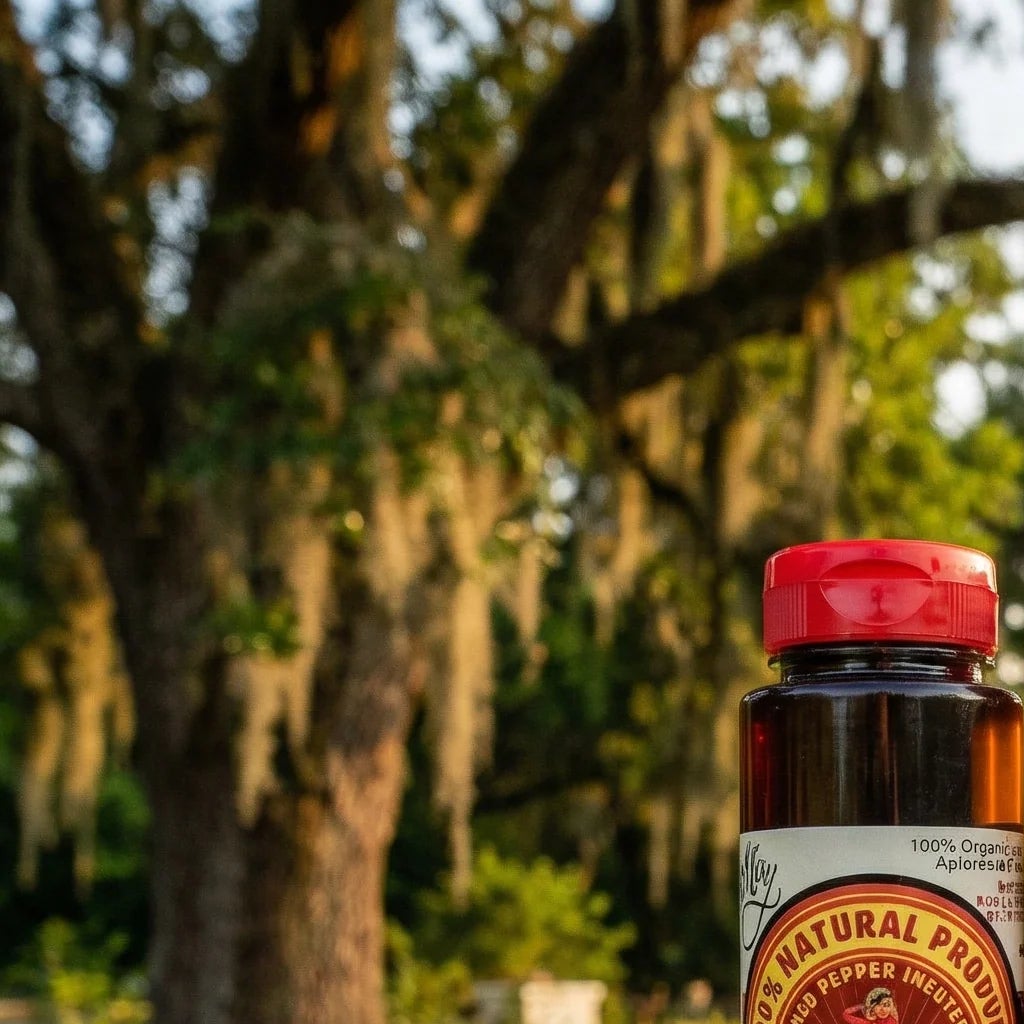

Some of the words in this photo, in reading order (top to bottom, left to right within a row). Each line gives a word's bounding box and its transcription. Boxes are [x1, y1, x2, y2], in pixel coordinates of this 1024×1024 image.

[911, 838, 956, 853] 100%
[775, 909, 919, 979] NATURAL
[816, 961, 896, 995] PEPPER
